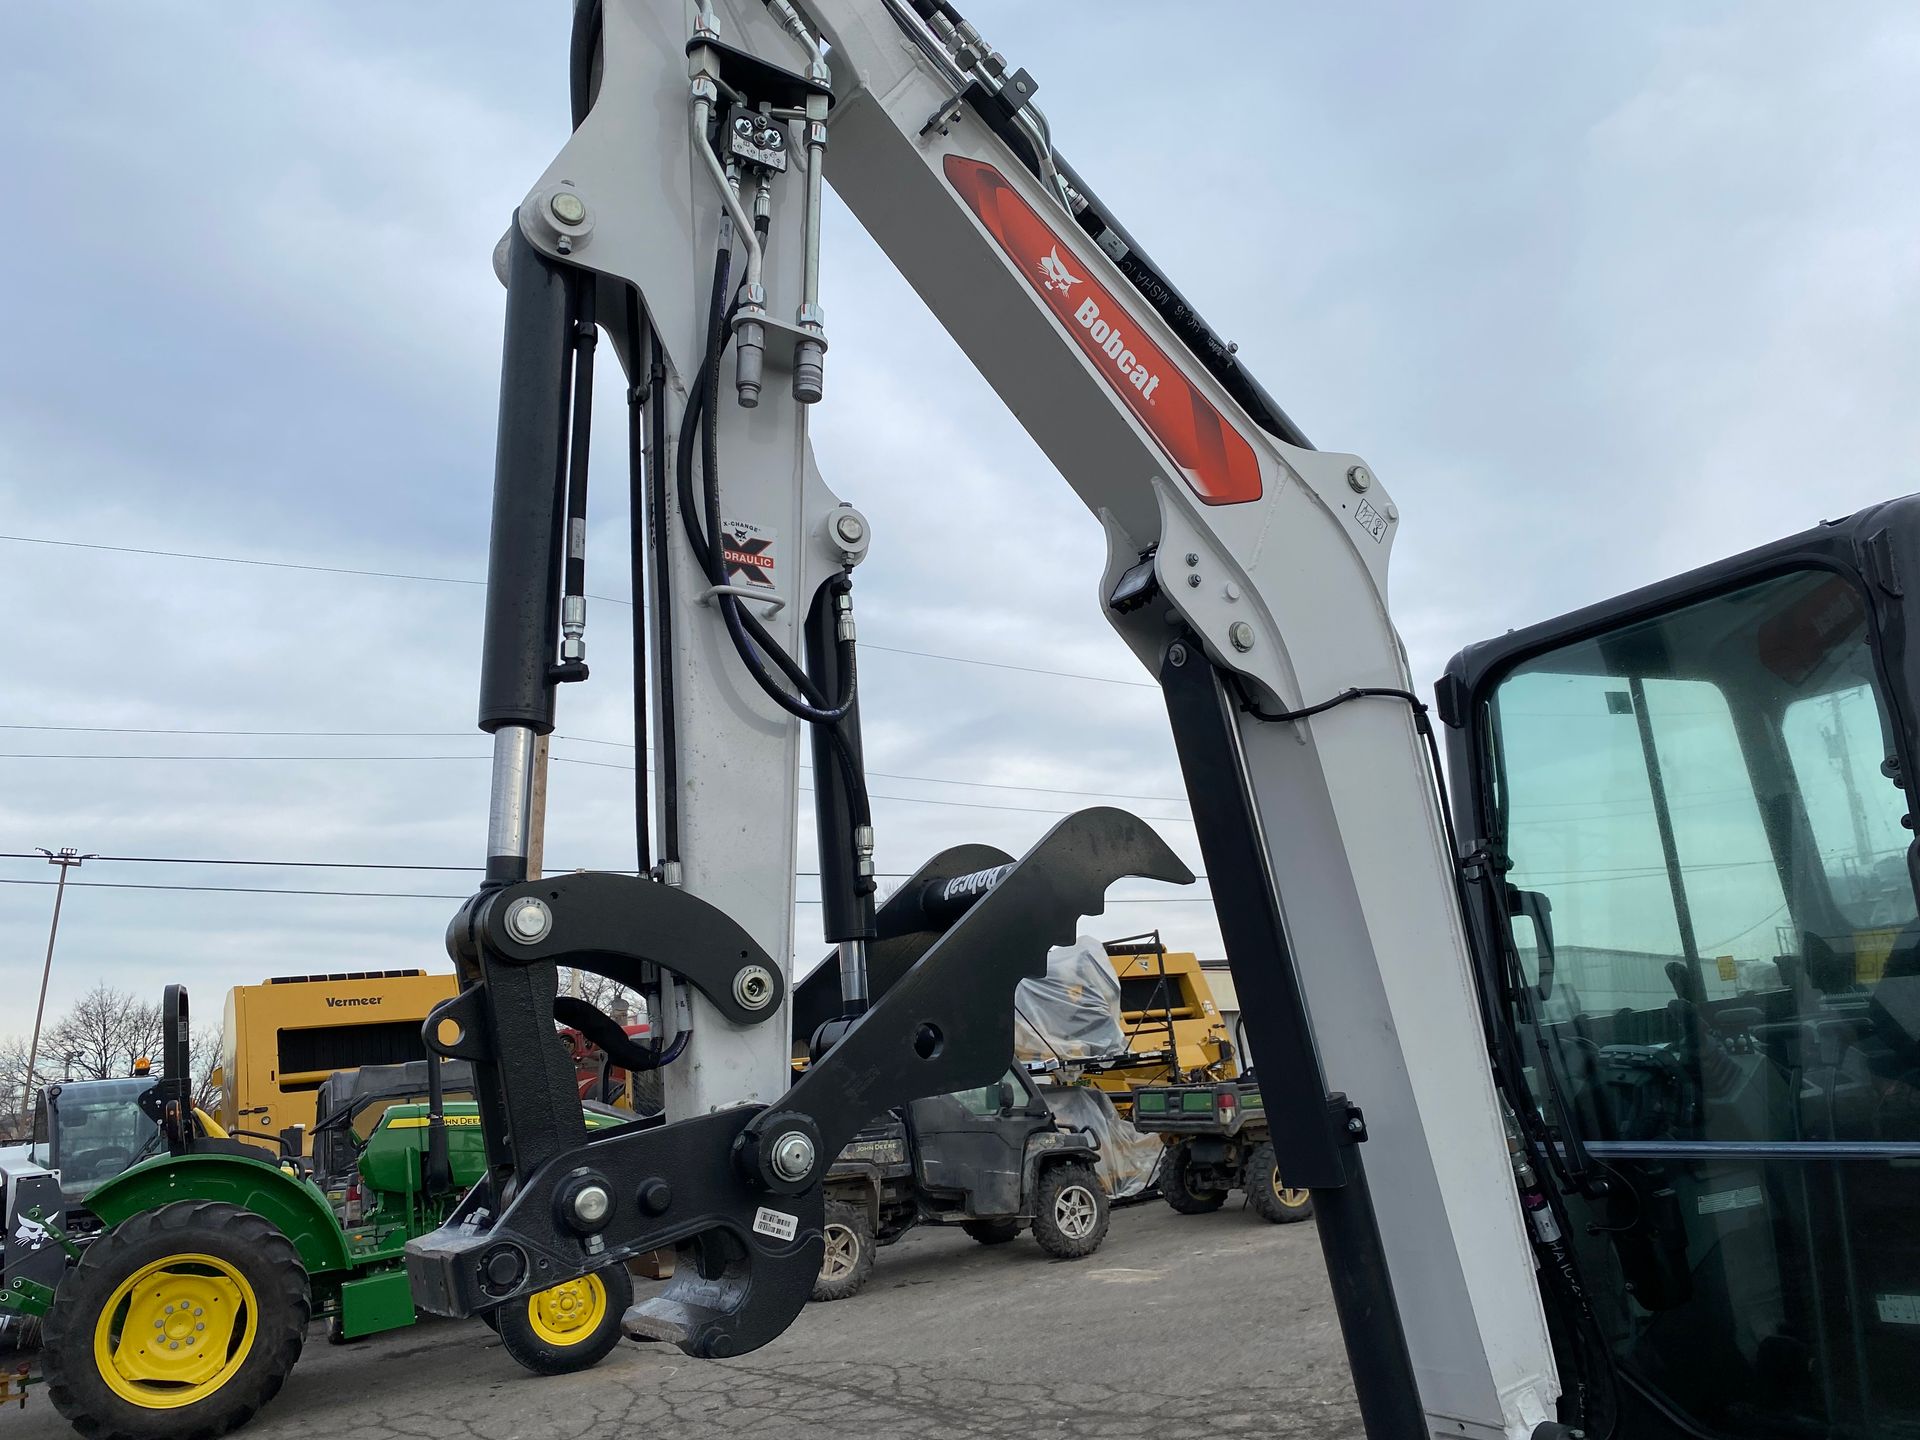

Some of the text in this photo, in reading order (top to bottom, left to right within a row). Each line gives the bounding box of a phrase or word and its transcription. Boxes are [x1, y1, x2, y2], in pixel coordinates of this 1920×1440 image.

[1135, 271, 1170, 305] MSHA
[1074, 297, 1159, 400] Bobcat
[723, 521, 758, 532] X-CHANGE
[723, 551, 771, 567] DRAULIC
[943, 866, 1004, 901] Bobcat
[325, 997, 382, 1008] Vermeer
